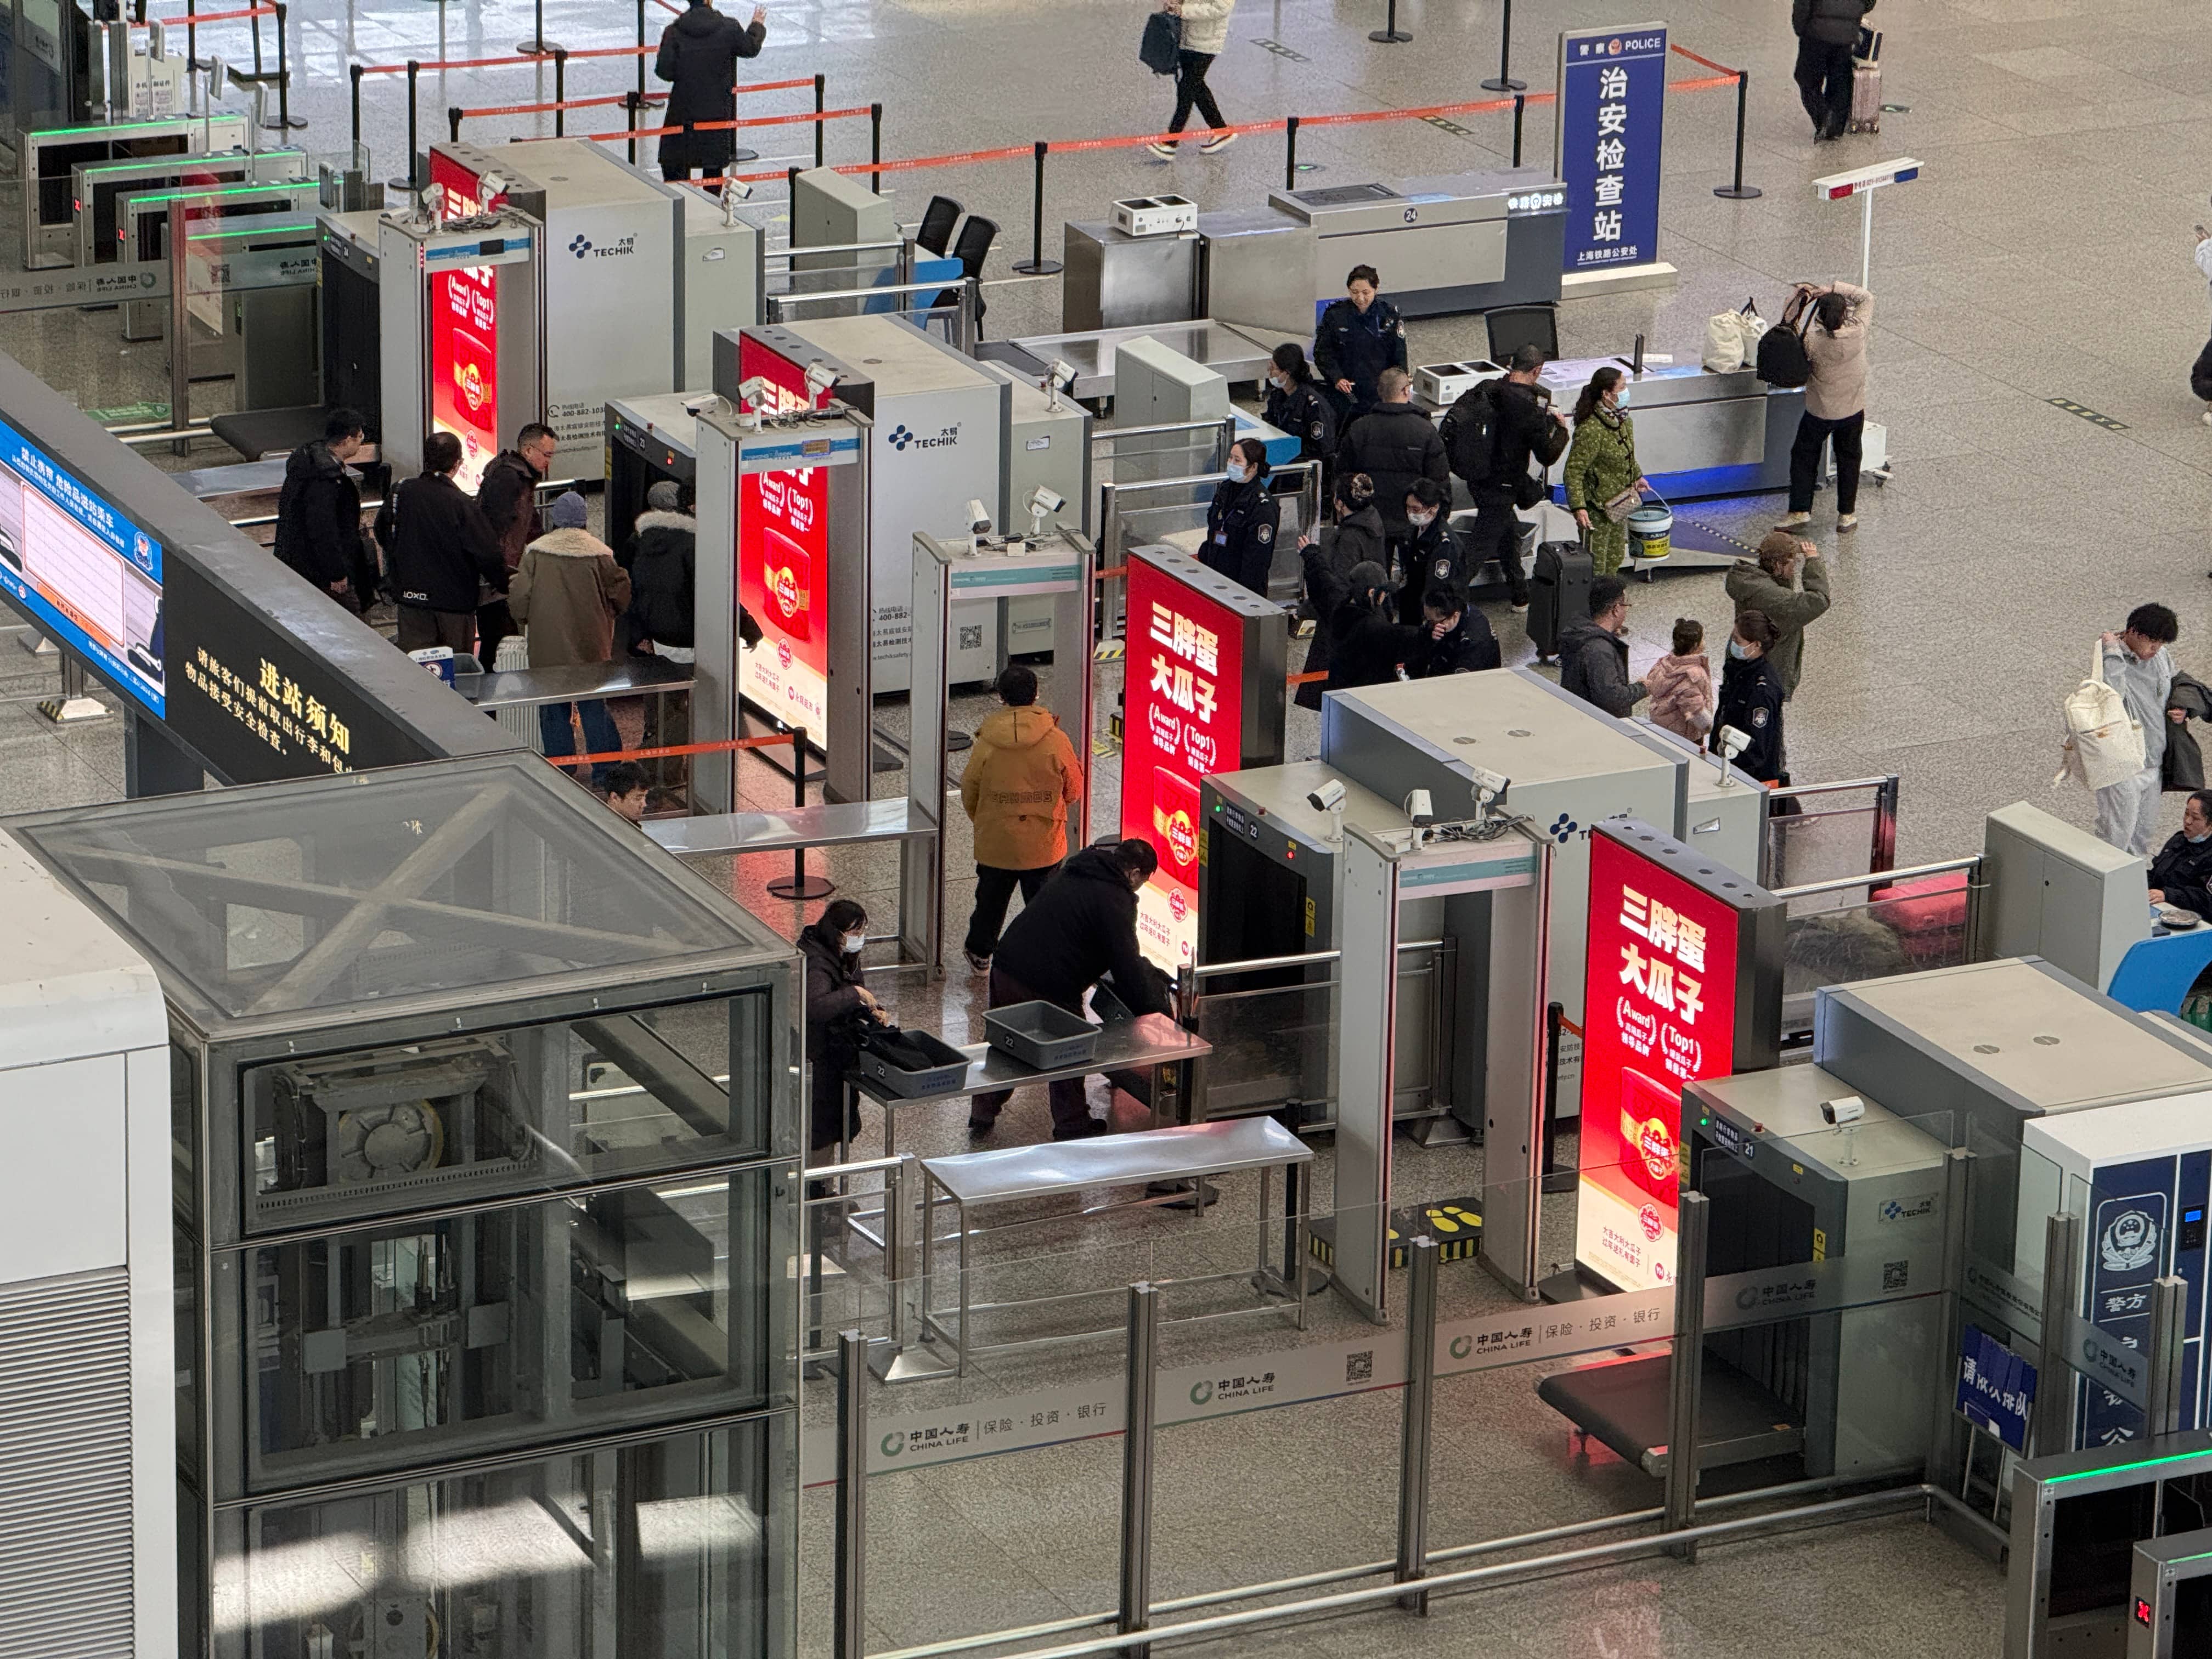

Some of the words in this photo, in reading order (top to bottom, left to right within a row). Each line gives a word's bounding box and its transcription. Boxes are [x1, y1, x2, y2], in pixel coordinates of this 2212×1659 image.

[1626, 37, 1661, 50] POLICE
[1593, 66, 1628, 241] 治安检查站
[1406, 210, 1417, 220] 24
[594, 246, 634, 258] TECHIK
[1577, 245, 1638, 262] 上海铁路公安处
[476, 290, 489, 311] Top1
[914, 437, 957, 449] TECHIK
[21, 446, 54, 481] 禁止携带
[56, 474, 114, 528] 危险品进站乘车
[763, 471, 781, 494] Award
[792, 488, 808, 510] Top1
[1149, 600, 1218, 676] 三胖蛋
[1150, 653, 1217, 724] 大瓜子
[196, 645, 353, 773] 请旅客们提前取出行李和包
[259, 657, 350, 755] 进站须知
[1154, 705, 1176, 730] Award
[1190, 725, 1210, 751] Top1
[1250, 825, 1257, 838] 22
[1619, 883, 1706, 973] 三胖蛋
[1619, 943, 1703, 1025] 大瓜子
[1623, 1000, 1651, 1029] Award
[1669, 1025, 1694, 1054] Top1
[1745, 1143, 1753, 1157] 21
[1901, 1207, 1931, 1218] TECHIK
[1763, 1279, 1816, 1297] 中国人寿
[1762, 1295, 1791, 1306] CHINA
[1794, 1292, 1815, 1301] LIFE
[2104, 1293, 2147, 1313] 警方
[1476, 1327, 1533, 1346] 中国人寿
[1476, 1344, 1508, 1355] CHINA
[1510, 1340, 1531, 1349] LIFE
[1217, 1372, 1276, 1391] 中国人寿
[1217, 1390, 1250, 1401] CHINA
[1252, 1385, 1274, 1395] LIFE
[910, 1423, 970, 1443] 中国人寿
[910, 1440, 943, 1452] CHINA
[946, 1436, 969, 1446] LIFE
